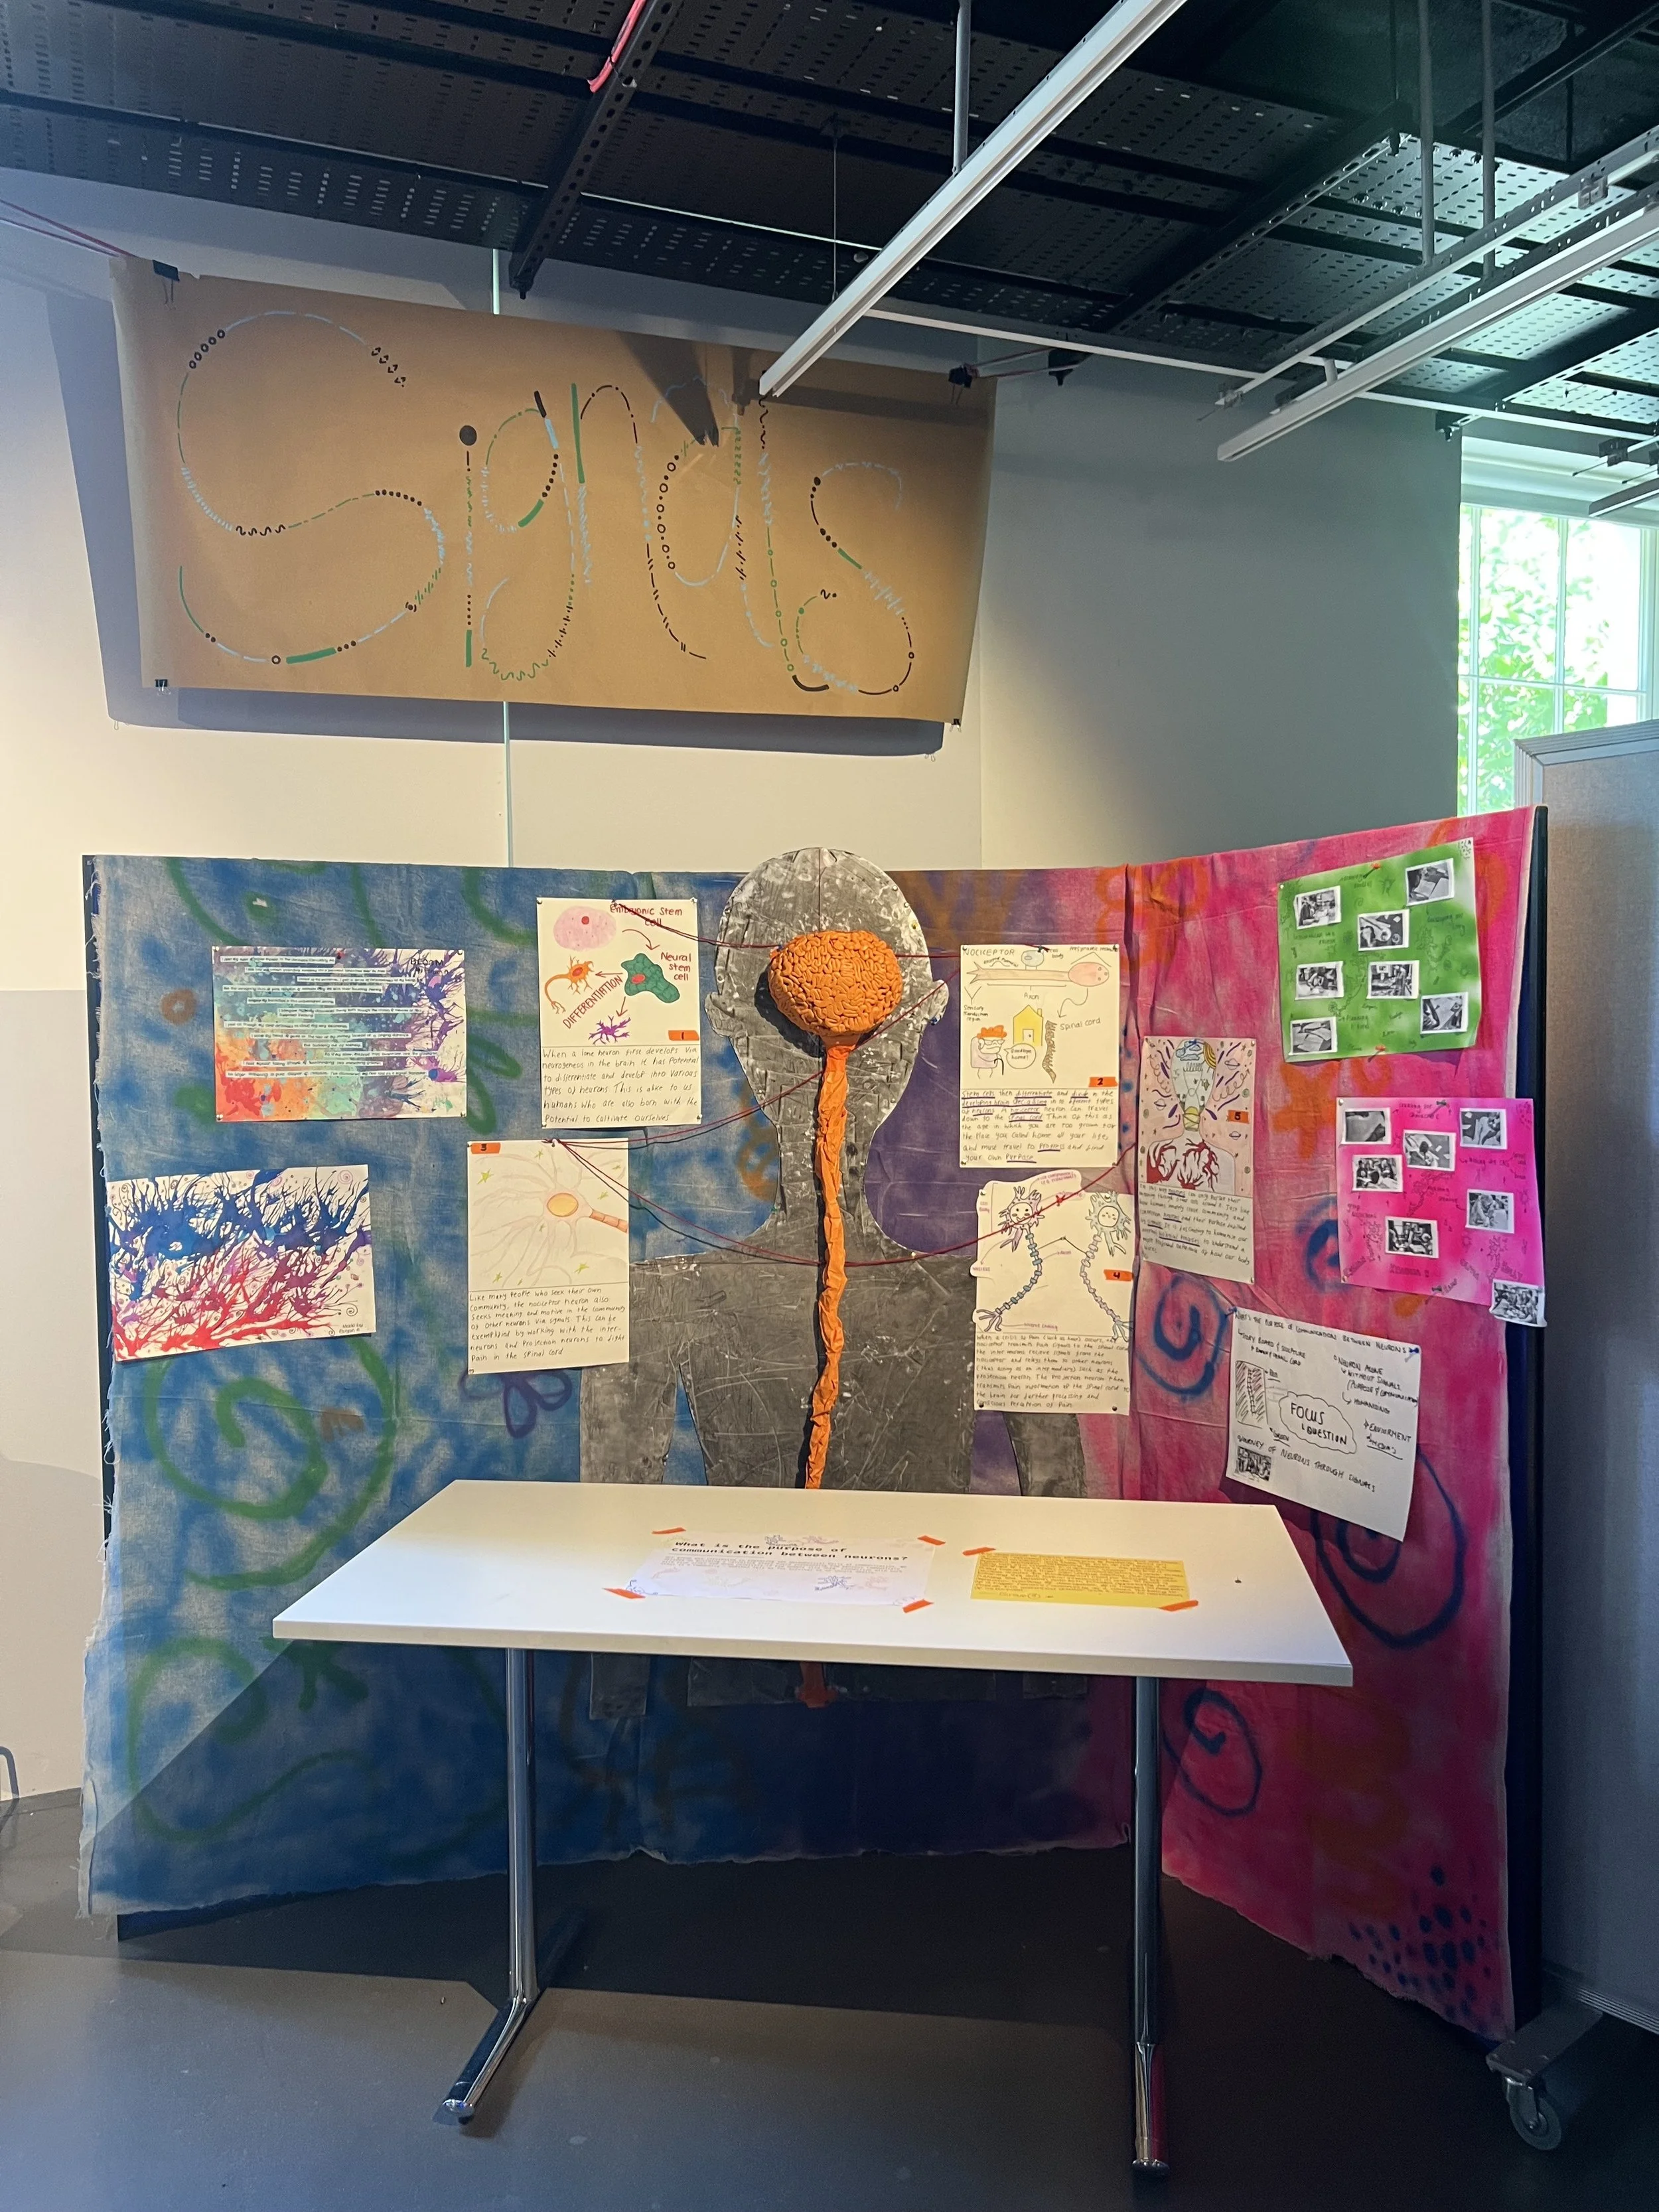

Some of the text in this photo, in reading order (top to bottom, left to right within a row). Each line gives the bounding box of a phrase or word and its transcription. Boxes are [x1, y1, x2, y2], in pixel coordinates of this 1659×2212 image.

[661, 952, 691, 962] Neural
[669, 963, 691, 972] stem
[563, 975, 623, 1029] DIFFERENTIATION
[1085, 1017, 1100, 1026] cord
[543, 1049, 566, 1058] When
[544, 1086, 561, 1096] types
[568, 1086, 575, 1094] of
[614, 1081, 631, 1093] This
[543, 1100, 577, 1109] humans
[640, 1098, 657, 1106] born
[664, 1096, 681, 1105] with
[686, 1097, 697, 1106] the
[1234, 1112, 1241, 1120] 5
[527, 1327, 554, 1336] working
[1375, 1342, 1406, 1354] NEURONS
[1291, 1402, 1325, 1425] FOCUS
[1307, 1426, 1347, 1445] QUESTION
[1281, 1449, 1310, 1465] NEURONS
[1314, 1461, 1344, 1479] THROUGH
